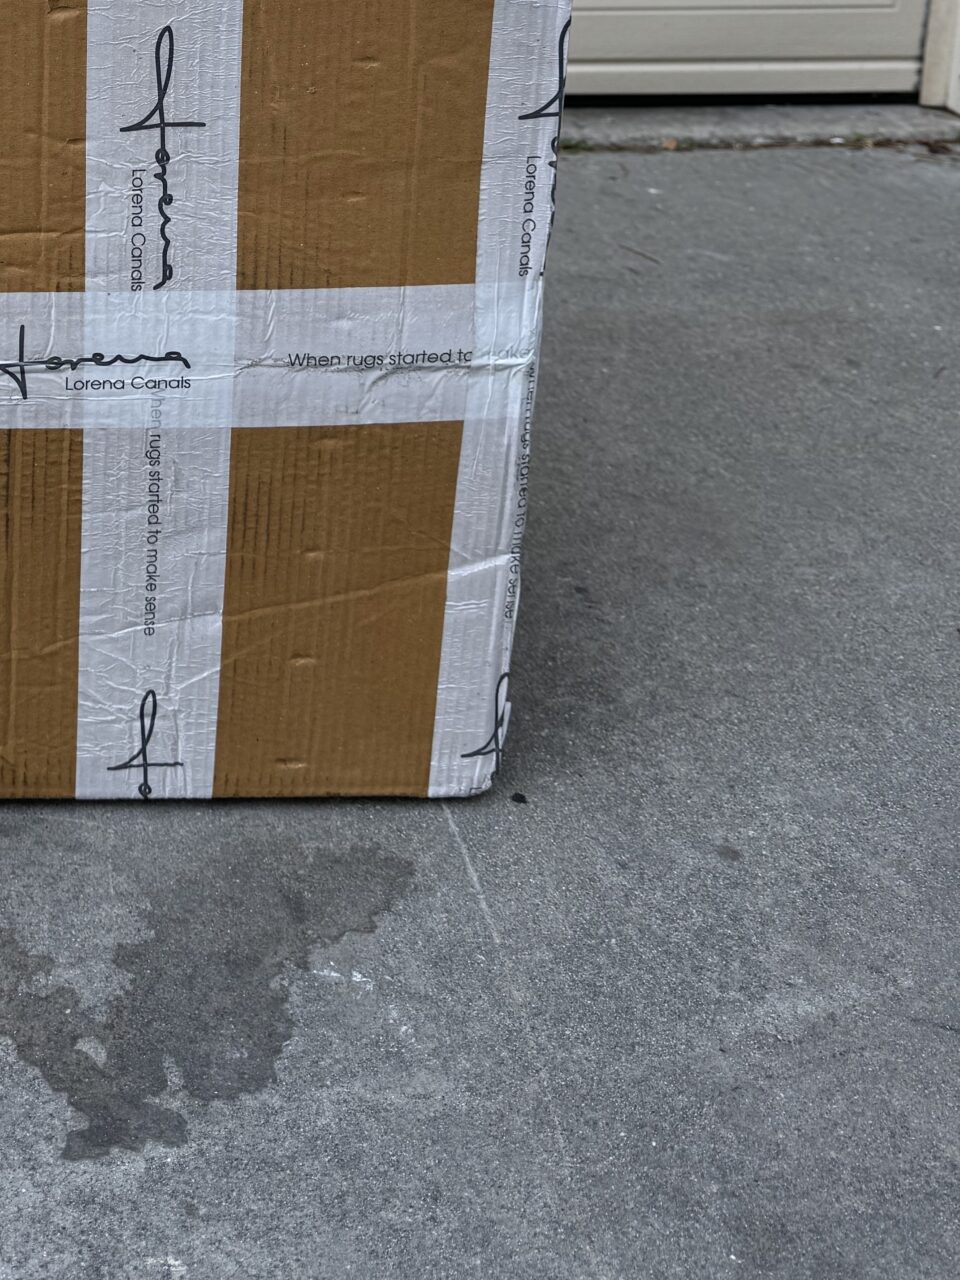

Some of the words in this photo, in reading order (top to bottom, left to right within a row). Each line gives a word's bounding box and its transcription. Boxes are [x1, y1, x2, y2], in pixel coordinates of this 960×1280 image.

[131, 169, 146, 227] Lorena
[523, 155, 542, 214] Lorena
[131, 232, 146, 292] Canals
[518, 217, 537, 277] Canals
[288, 352, 341, 367] When
[346, 353, 384, 369] rugs
[389, 348, 453, 366] started
[65, 377, 125, 391] Lorena
[130, 375, 192, 391] Canals
[145, 434, 161, 467] rugs
[146, 470, 163, 525] started
[146, 528, 162, 545] to
[145, 548, 161, 592] make
[143, 596, 157, 637] sense
